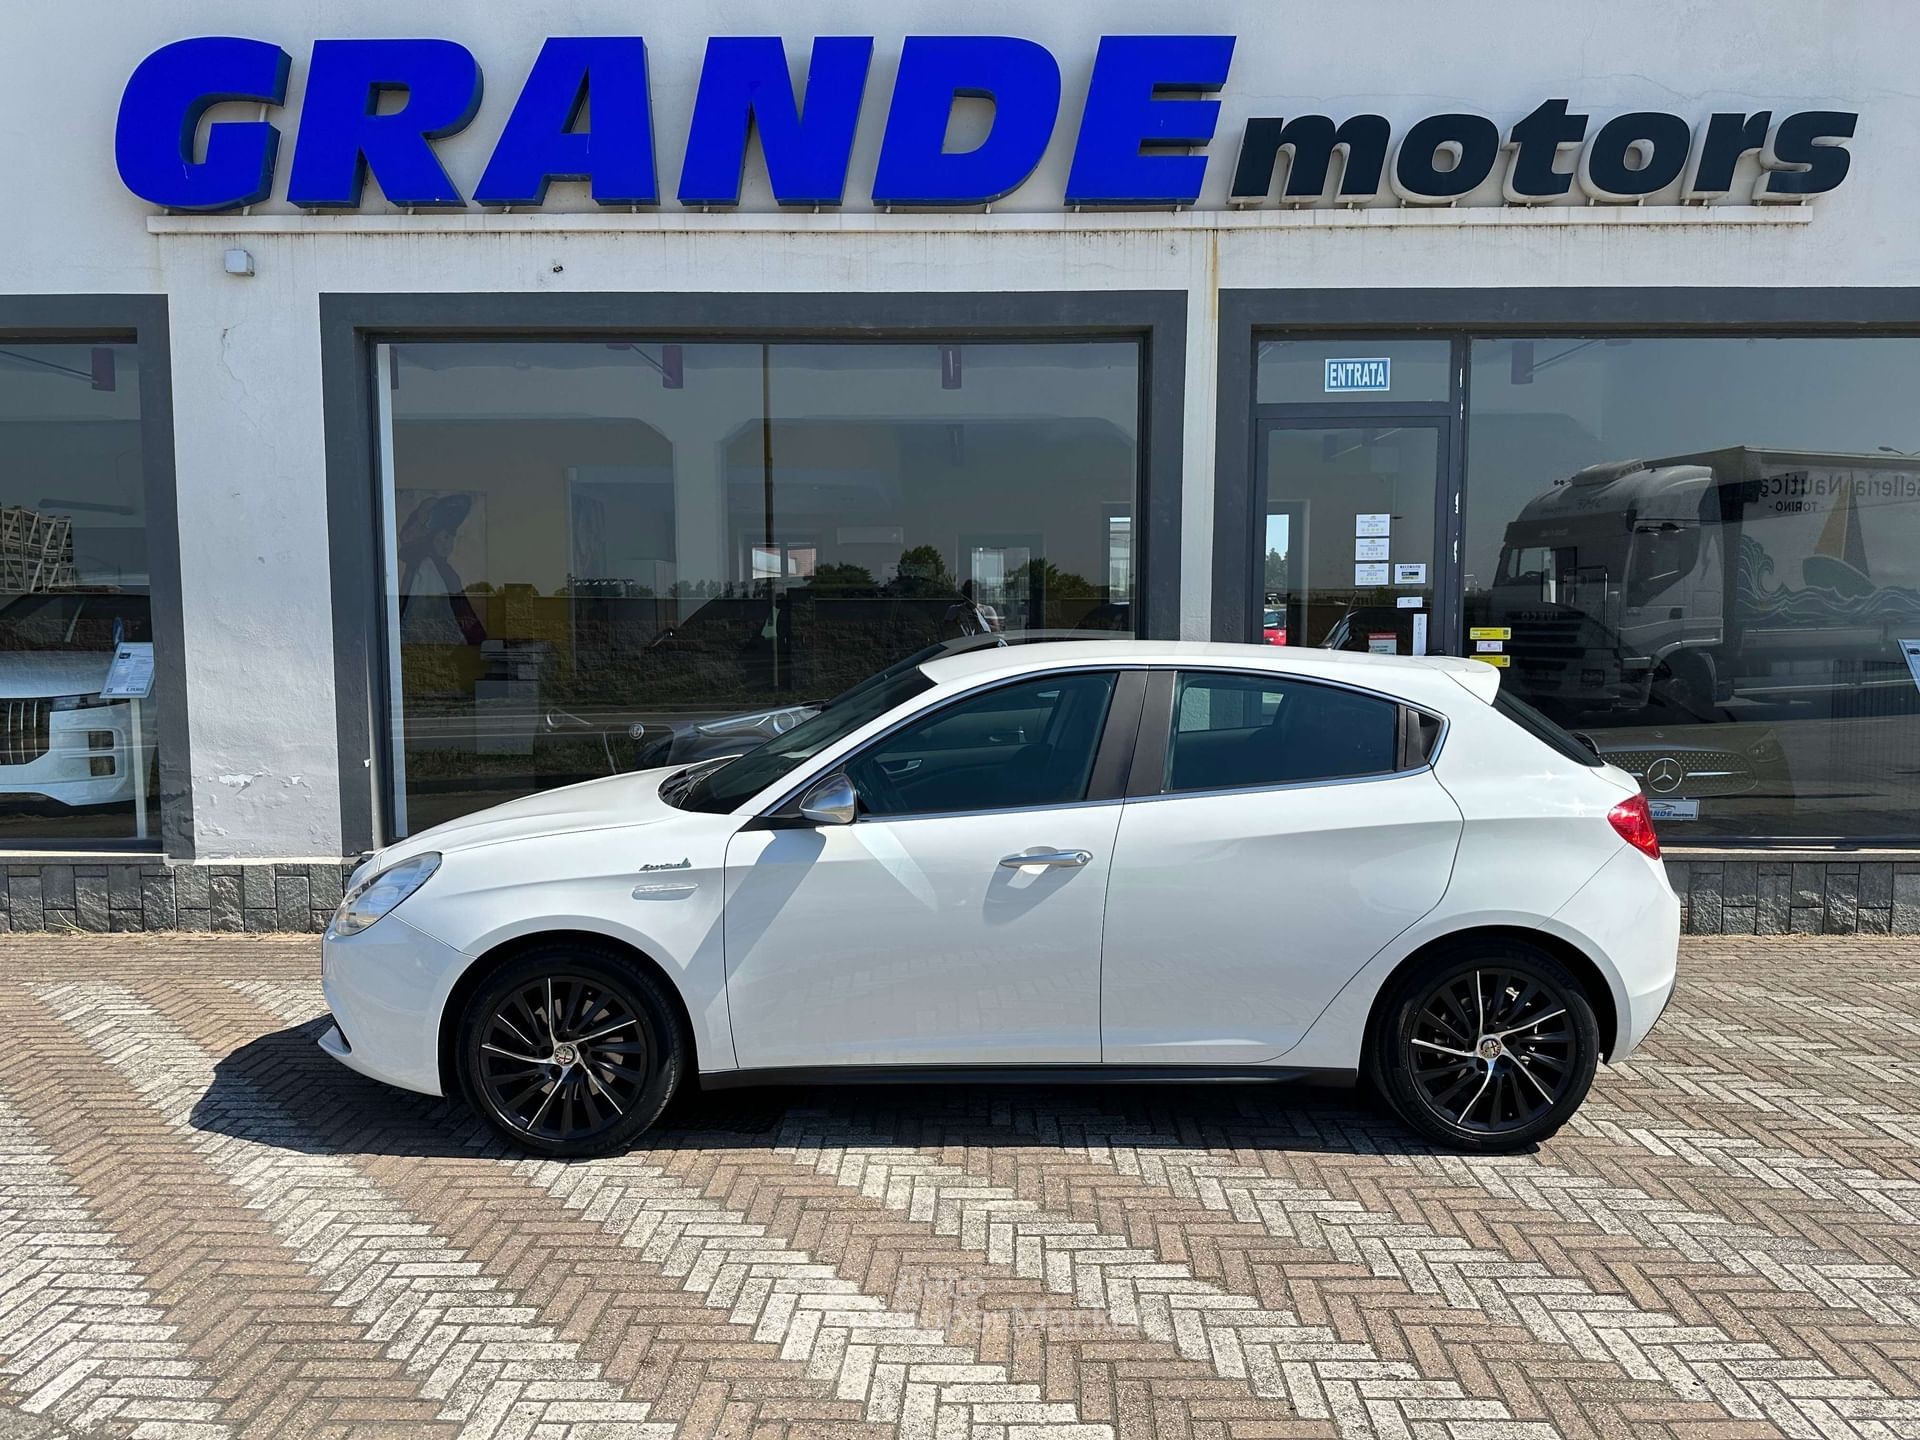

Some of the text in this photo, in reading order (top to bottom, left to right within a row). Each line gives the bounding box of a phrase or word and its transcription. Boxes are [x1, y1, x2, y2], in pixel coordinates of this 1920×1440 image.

[115, 36, 1859, 208] GRANDE motors
[1329, 362, 1385, 387] ENTRATA
